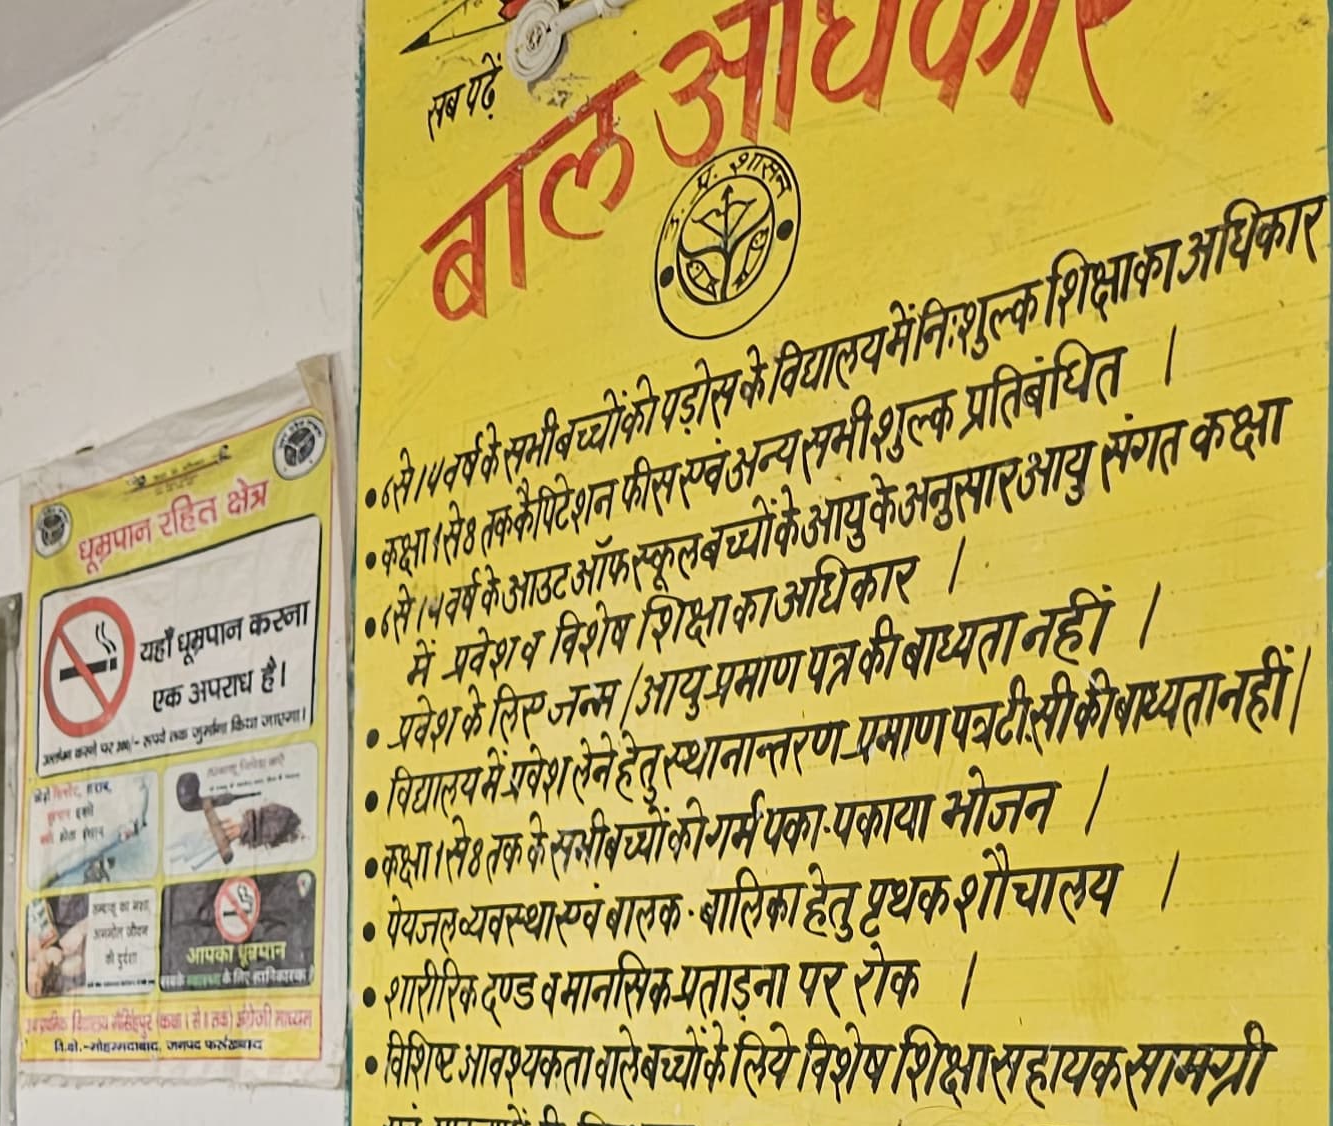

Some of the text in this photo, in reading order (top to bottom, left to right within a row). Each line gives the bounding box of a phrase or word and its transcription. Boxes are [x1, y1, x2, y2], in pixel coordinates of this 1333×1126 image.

[428, 83, 466, 142] सब
[421, 70, 644, 321] बाल
[503, 407, 558, 484] सभी
[556, 389, 625, 461] बच्चों
[623, 374, 660, 442] को
[660, 358, 742, 436] पड़ोस
[739, 344, 769, 409] के
[769, 339, 889, 405] विद्यालय
[888, 300, 917, 366] में
[1044, 249, 1138, 328] शिक्षा
[1134, 239, 1181, 298] का
[1179, 195, 1328, 284] अधिकार
[159, 494, 218, 537] रहित
[227, 478, 269, 515] क्षेत्र
[382, 517, 433, 576] कक्षा
[621, 455, 680, 517] फीस
[724, 429, 802, 492] अन्य
[800, 394, 872, 484] सभी
[871, 389, 957, 464] शुल्क
[959, 338, 1128, 440] प्रतिबंधित
[140, 625, 174, 663] यहाँ
[249, 600, 310, 637] करना
[388, 695, 462, 752] प्रवेश
[460, 685, 484, 740] के
[548, 679, 621, 726] जन्म
[704, 649, 805, 708] प्रमाण
[807, 638, 859, 696] पत्र
[858, 614, 904, 686] की
[903, 611, 1028, 680] बाध्यता
[1022, 583, 1116, 665] नहीं
[407, 639, 438, 687] में
[441, 627, 520, 684] प्रवेश
[549, 602, 635, 667] विशेष
[637, 595, 732, 651] शिक्षा
[734, 585, 777, 634] का
[774, 553, 920, 624] अधिकार
[152, 684, 183, 713] एक
[188, 670, 254, 705] अपराध
[387, 765, 482, 817] विद्यालय
[482, 747, 508, 794] में
[572, 731, 618, 804] लेने
[614, 730, 664, 814] हेतु
[835, 708, 949, 766] प्रमाण
[952, 700, 1004, 754] पत्र
[1116, 672, 1226, 737] बाध्यता
[1218, 645, 1295, 734] नहीं
[387, 896, 460, 953] पेयजल
[460, 902, 558, 946] व्यवस्था
[606, 894, 683, 944] बालक
[700, 866, 806, 938] बालिका
[804, 862, 861, 942] हेतु
[954, 843, 1124, 933] शौचालय
[385, 958, 478, 1024] शारीरिक
[482, 972, 538, 1028] दण्ड
[541, 972, 561, 1018] व
[560, 950, 673, 1019] मानसिक
[799, 961, 848, 1016] पर
[854, 941, 921, 1017] रोक
[385, 1019, 1279, 1112] विशिष्ट आवश्यकता वाले बच्चों के लिये विशेष शिक्षा सहायक सामग्री
